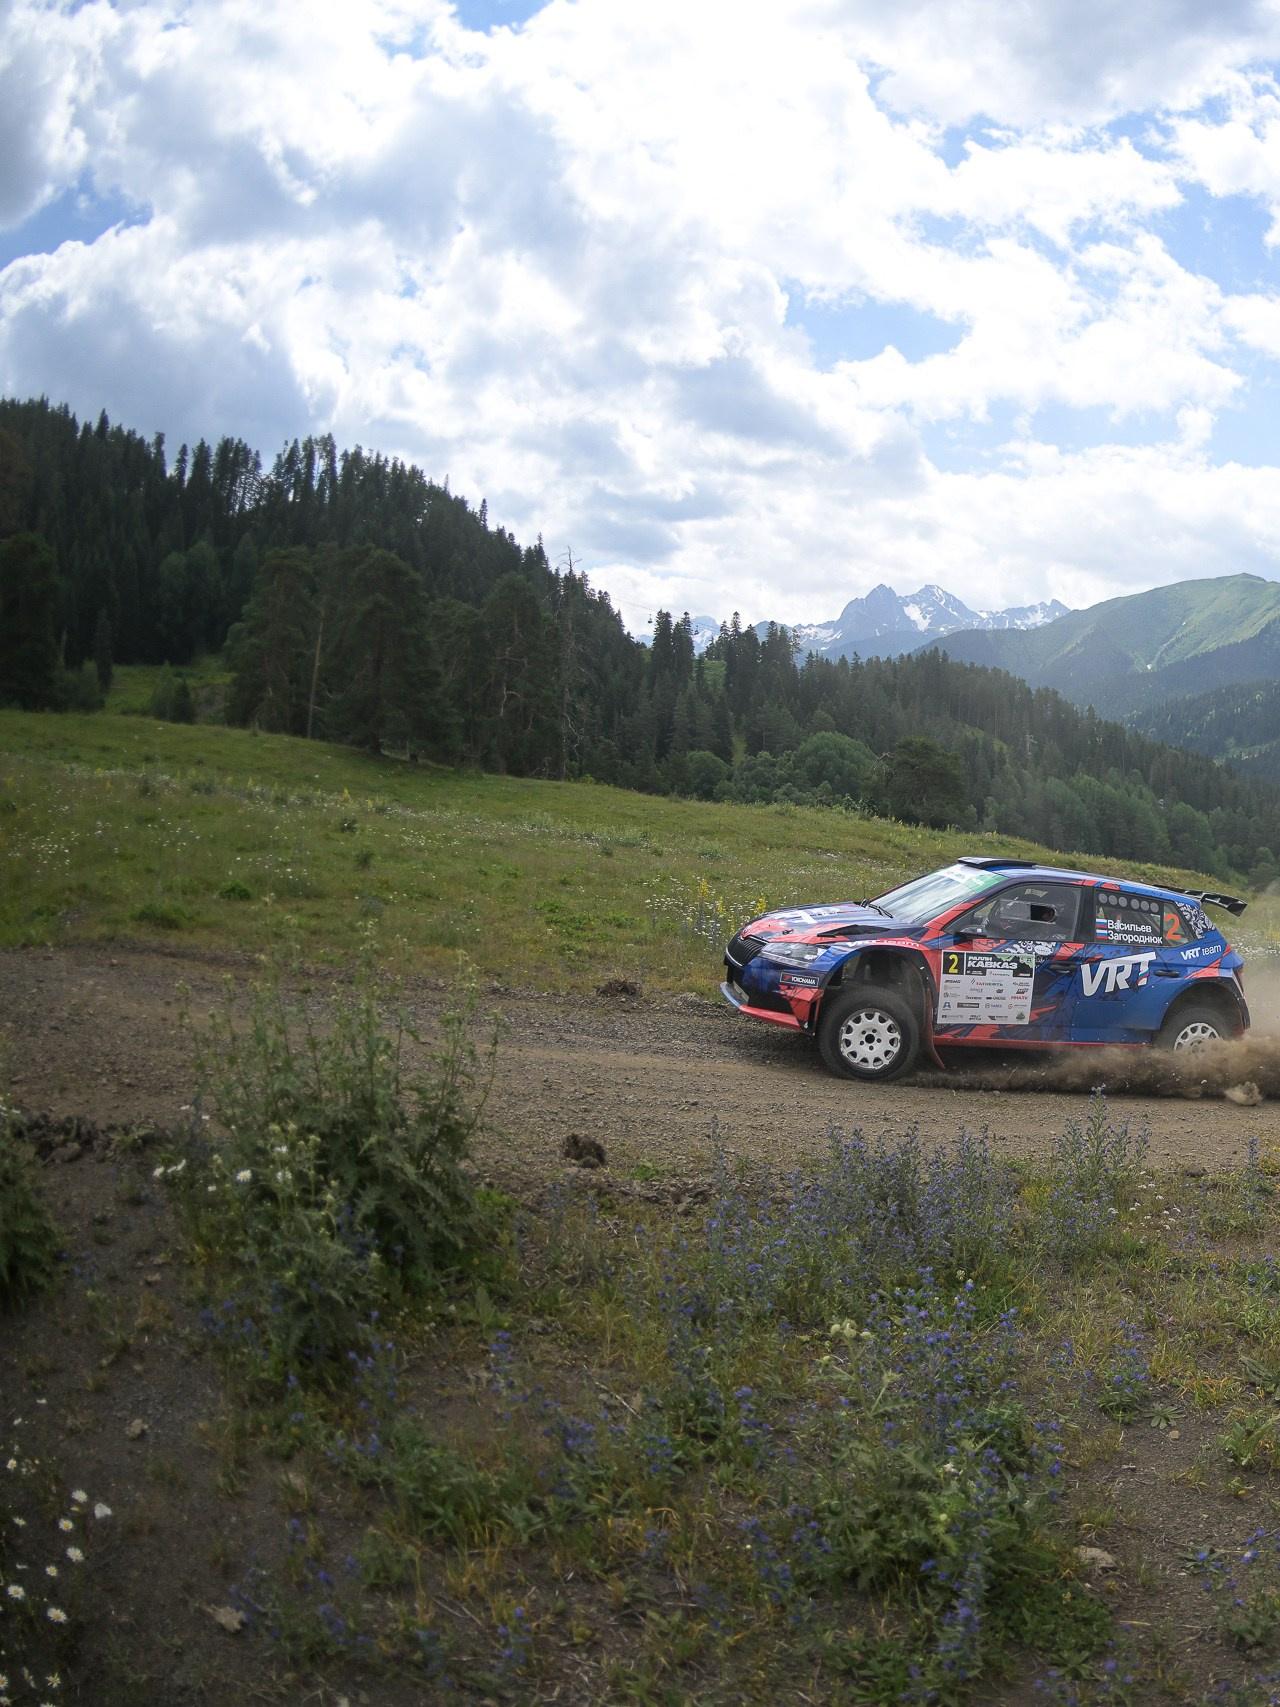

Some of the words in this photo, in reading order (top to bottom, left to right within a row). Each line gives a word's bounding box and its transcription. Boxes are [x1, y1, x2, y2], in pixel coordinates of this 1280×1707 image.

[1107, 919, 1152, 932] Васильев
[1164, 913, 1182, 941] 2
[1107, 930, 1163, 944] Загороднюк
[1180, 947, 1201, 960] VRT
[1202, 944, 1222, 956] team
[948, 953, 959, 974] 2
[967, 960, 1018, 969] КАВКАЗ
[791, 975, 816, 985] YOKOHAMA
[1080, 951, 1157, 997] VRT
